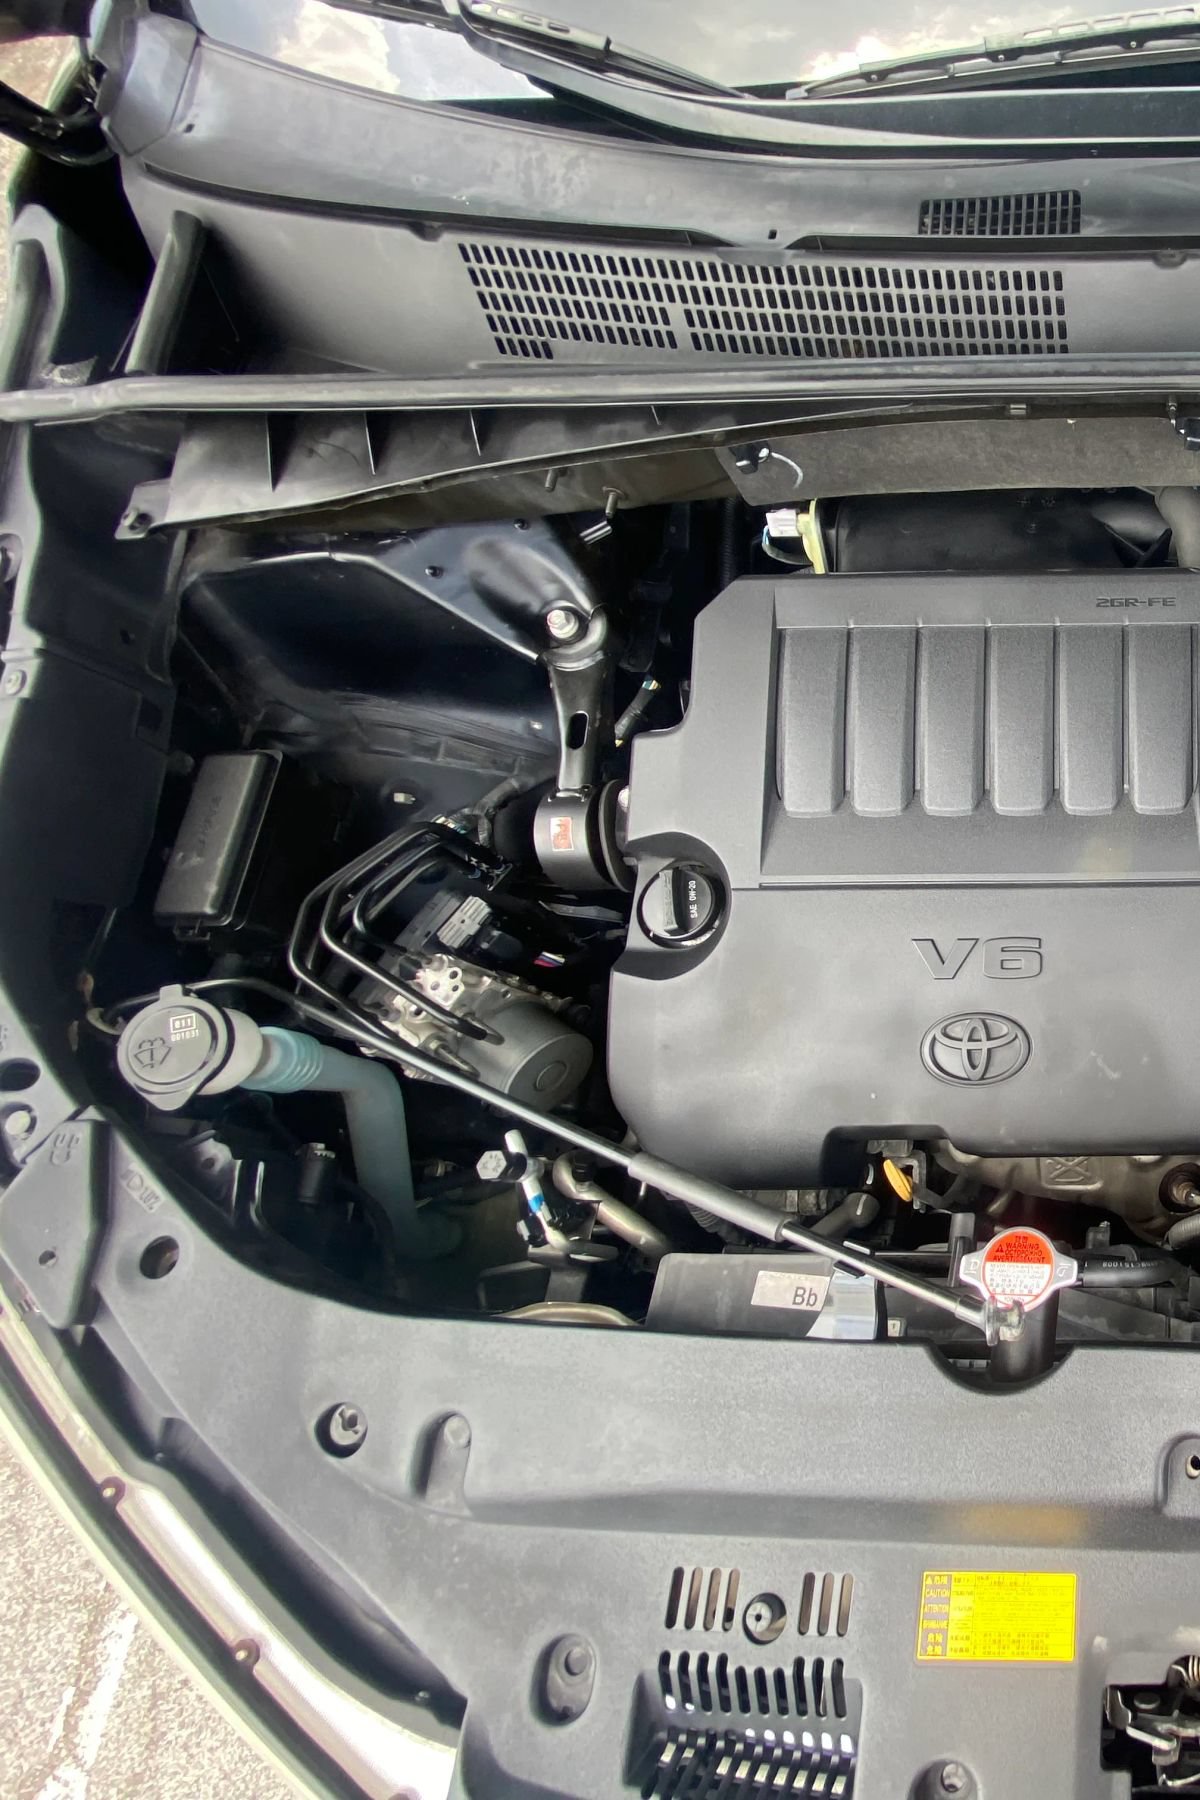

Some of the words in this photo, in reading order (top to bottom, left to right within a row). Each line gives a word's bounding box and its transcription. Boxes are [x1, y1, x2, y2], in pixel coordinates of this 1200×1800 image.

[1095, 597, 1177, 608] 2GR-FE
[690, 904, 698, 918] SAE
[911, 936, 1043, 980] V6
[792, 1287, 818, 1308] Bb
